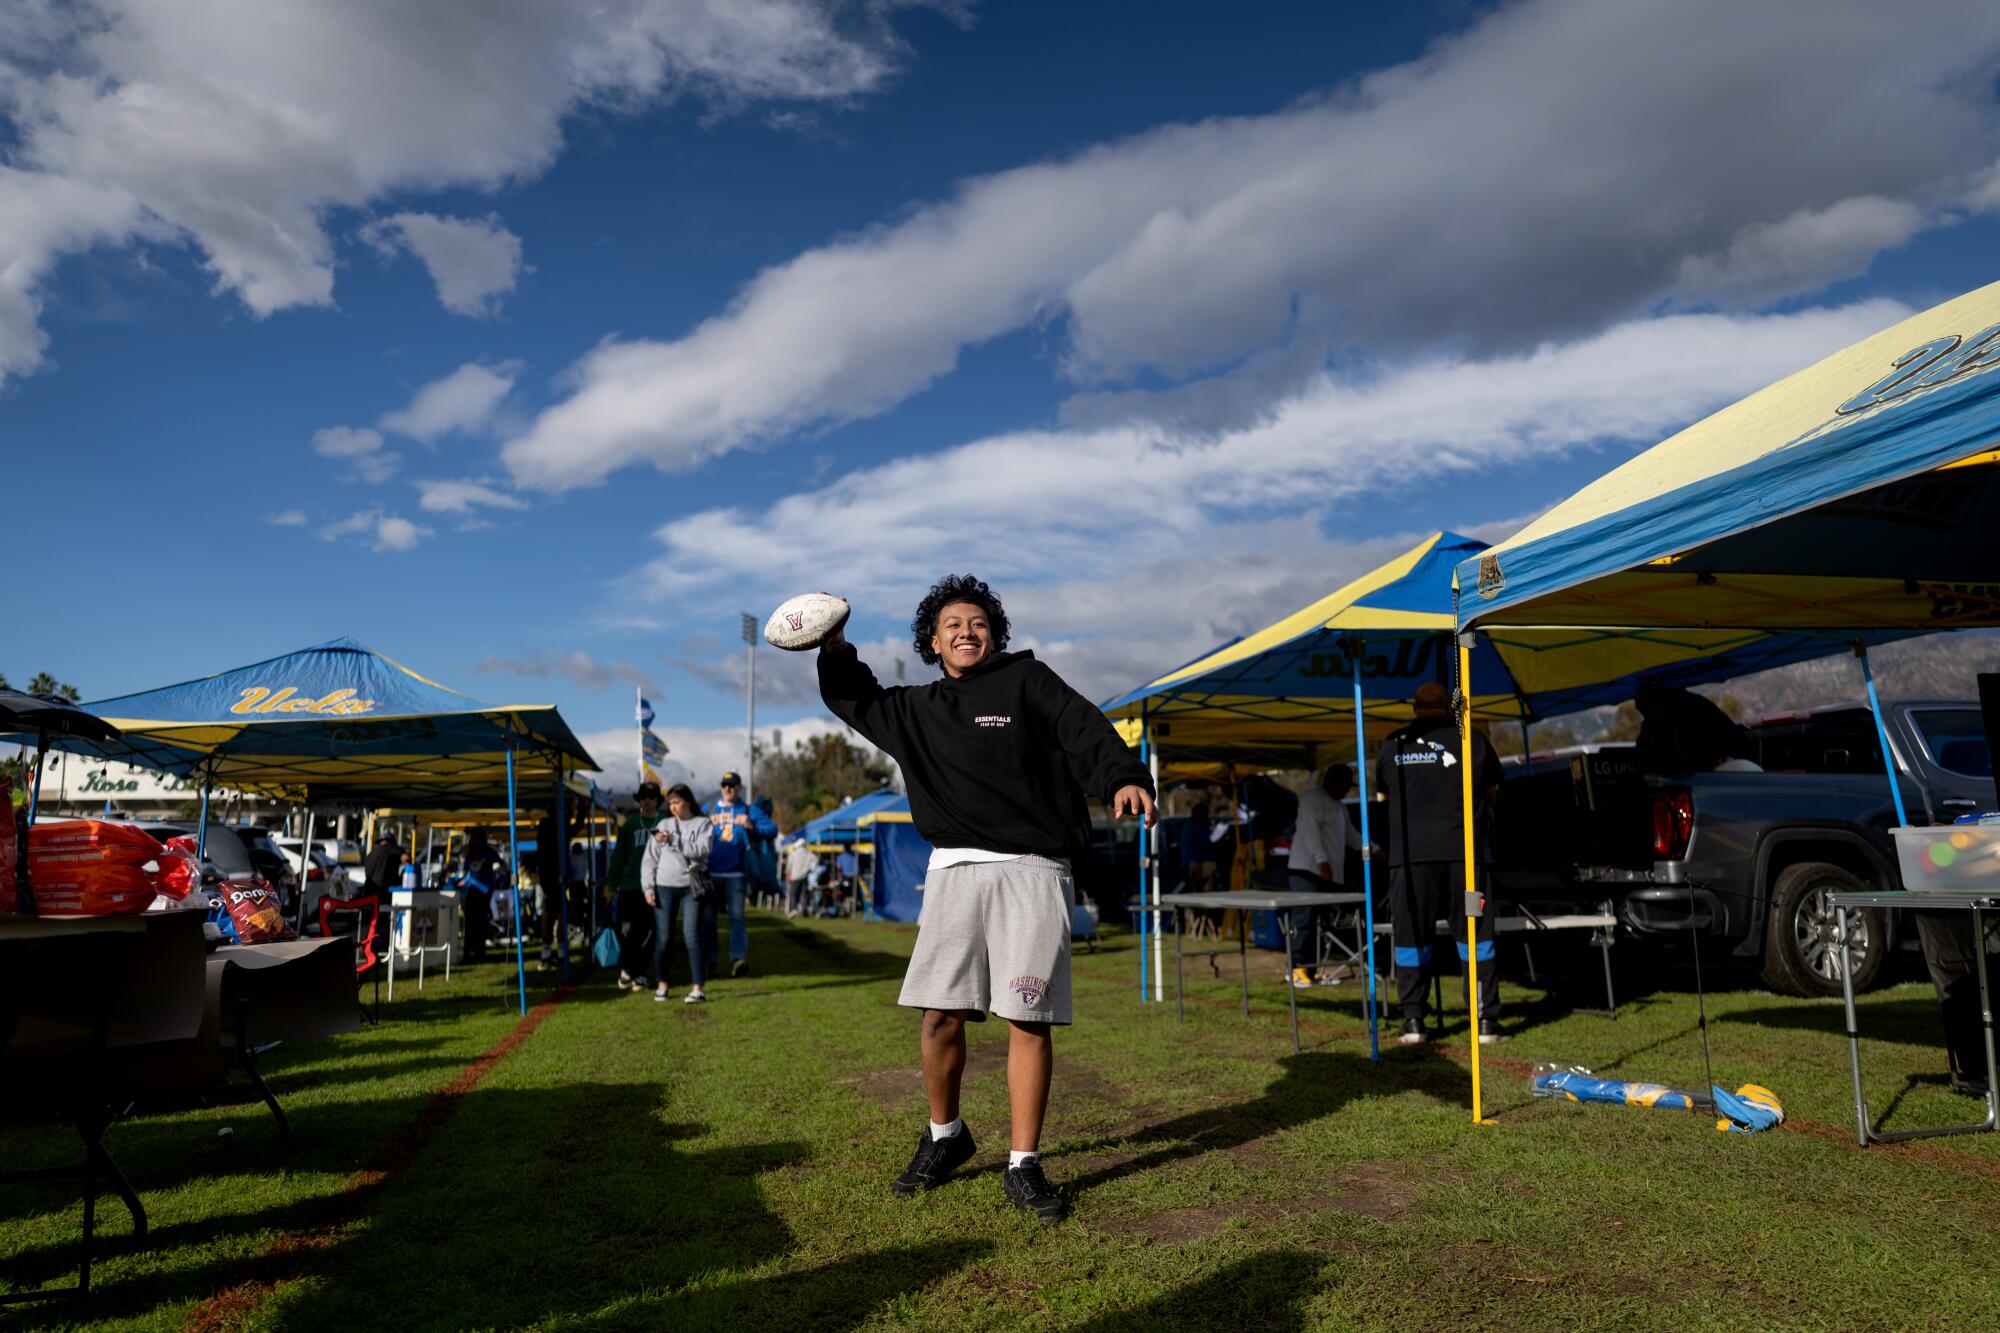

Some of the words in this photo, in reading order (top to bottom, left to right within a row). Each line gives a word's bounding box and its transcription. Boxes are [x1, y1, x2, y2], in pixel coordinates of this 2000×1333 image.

[230, 687, 376, 714] Ucla
[1394, 752, 1438, 763] OHANA
[1595, 761, 1611, 775] LG
[78, 769, 139, 793] Rose
[711, 812, 747, 825] UCLA
[230, 888, 277, 905] Dorit
